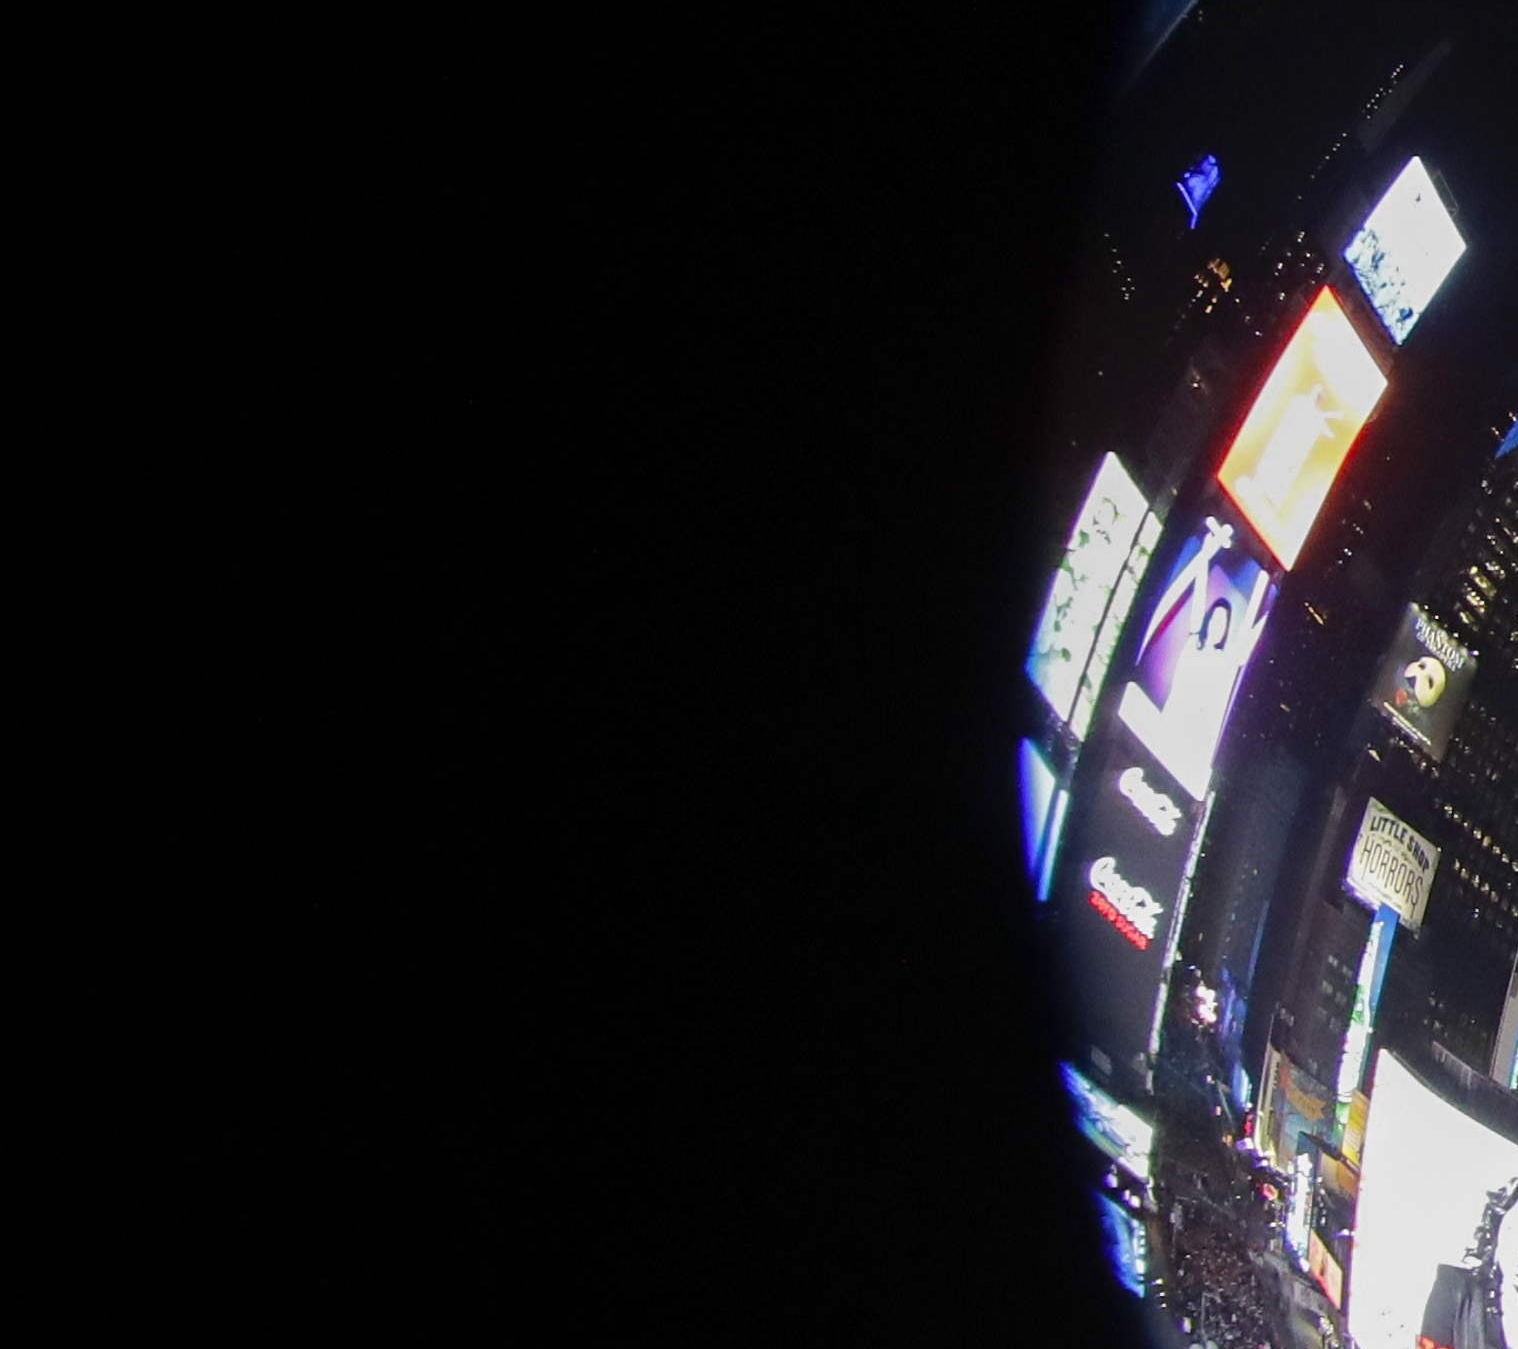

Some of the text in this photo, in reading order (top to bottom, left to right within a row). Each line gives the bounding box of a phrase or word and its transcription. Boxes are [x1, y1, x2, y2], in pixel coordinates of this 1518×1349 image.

[1416, 618, 1465, 669] PHANTOM
[1371, 815, 1430, 874] LITTLE SHOP
[1361, 836, 1422, 918] HORRORS
